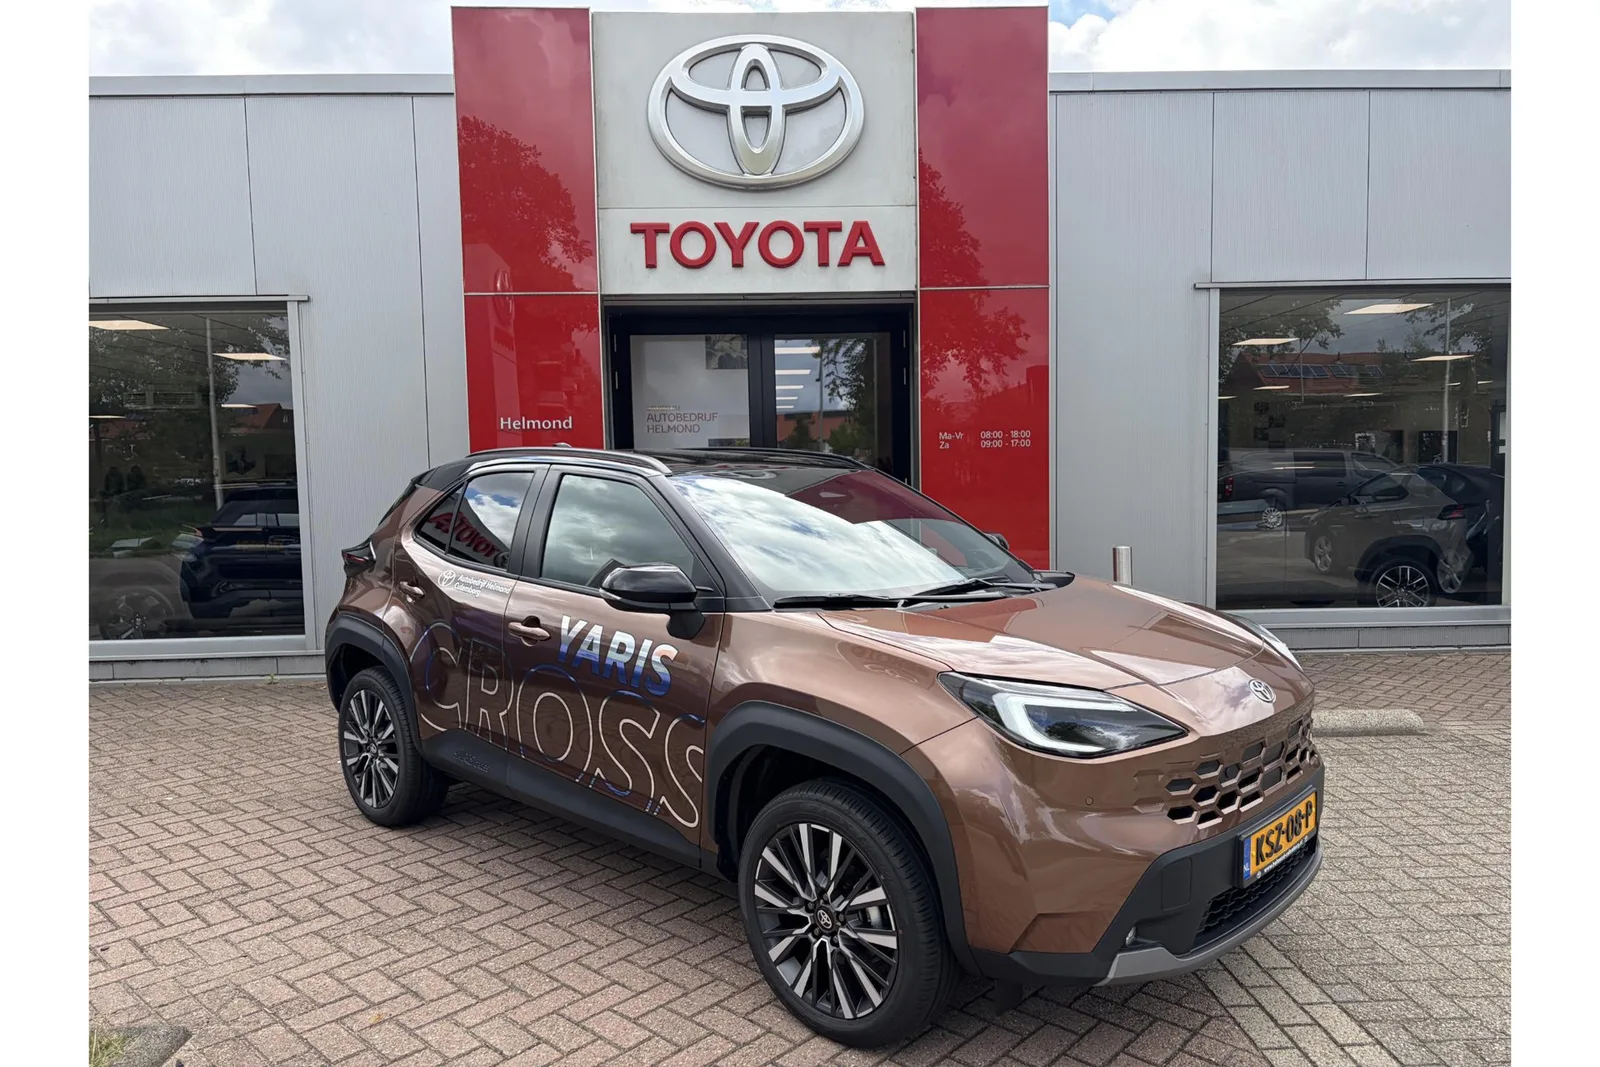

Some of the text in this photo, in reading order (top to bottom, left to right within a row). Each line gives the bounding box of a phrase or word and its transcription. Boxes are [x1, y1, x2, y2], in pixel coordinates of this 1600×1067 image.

[630, 220, 885, 269] TOYOTA
[500, 416, 573, 430] Helmond
[646, 412, 719, 422] AUTOBEDRIJF
[646, 423, 701, 434] HELMOND
[939, 432, 964, 440] Ma-Vr
[1011, 430, 1031, 438] 18:00
[939, 441, 950, 449] Za
[980, 440, 1003, 448] 09:00
[1011, 439, 1031, 447] 17:00
[454, 582, 482, 598] Culemborg
[457, 574, 511, 595] Autobedrijf Helmond
[558, 614, 679, 697] YARIS
[409, 621, 706, 828] CROSS
[1256, 800, 1313, 866] KSZ-08-P
